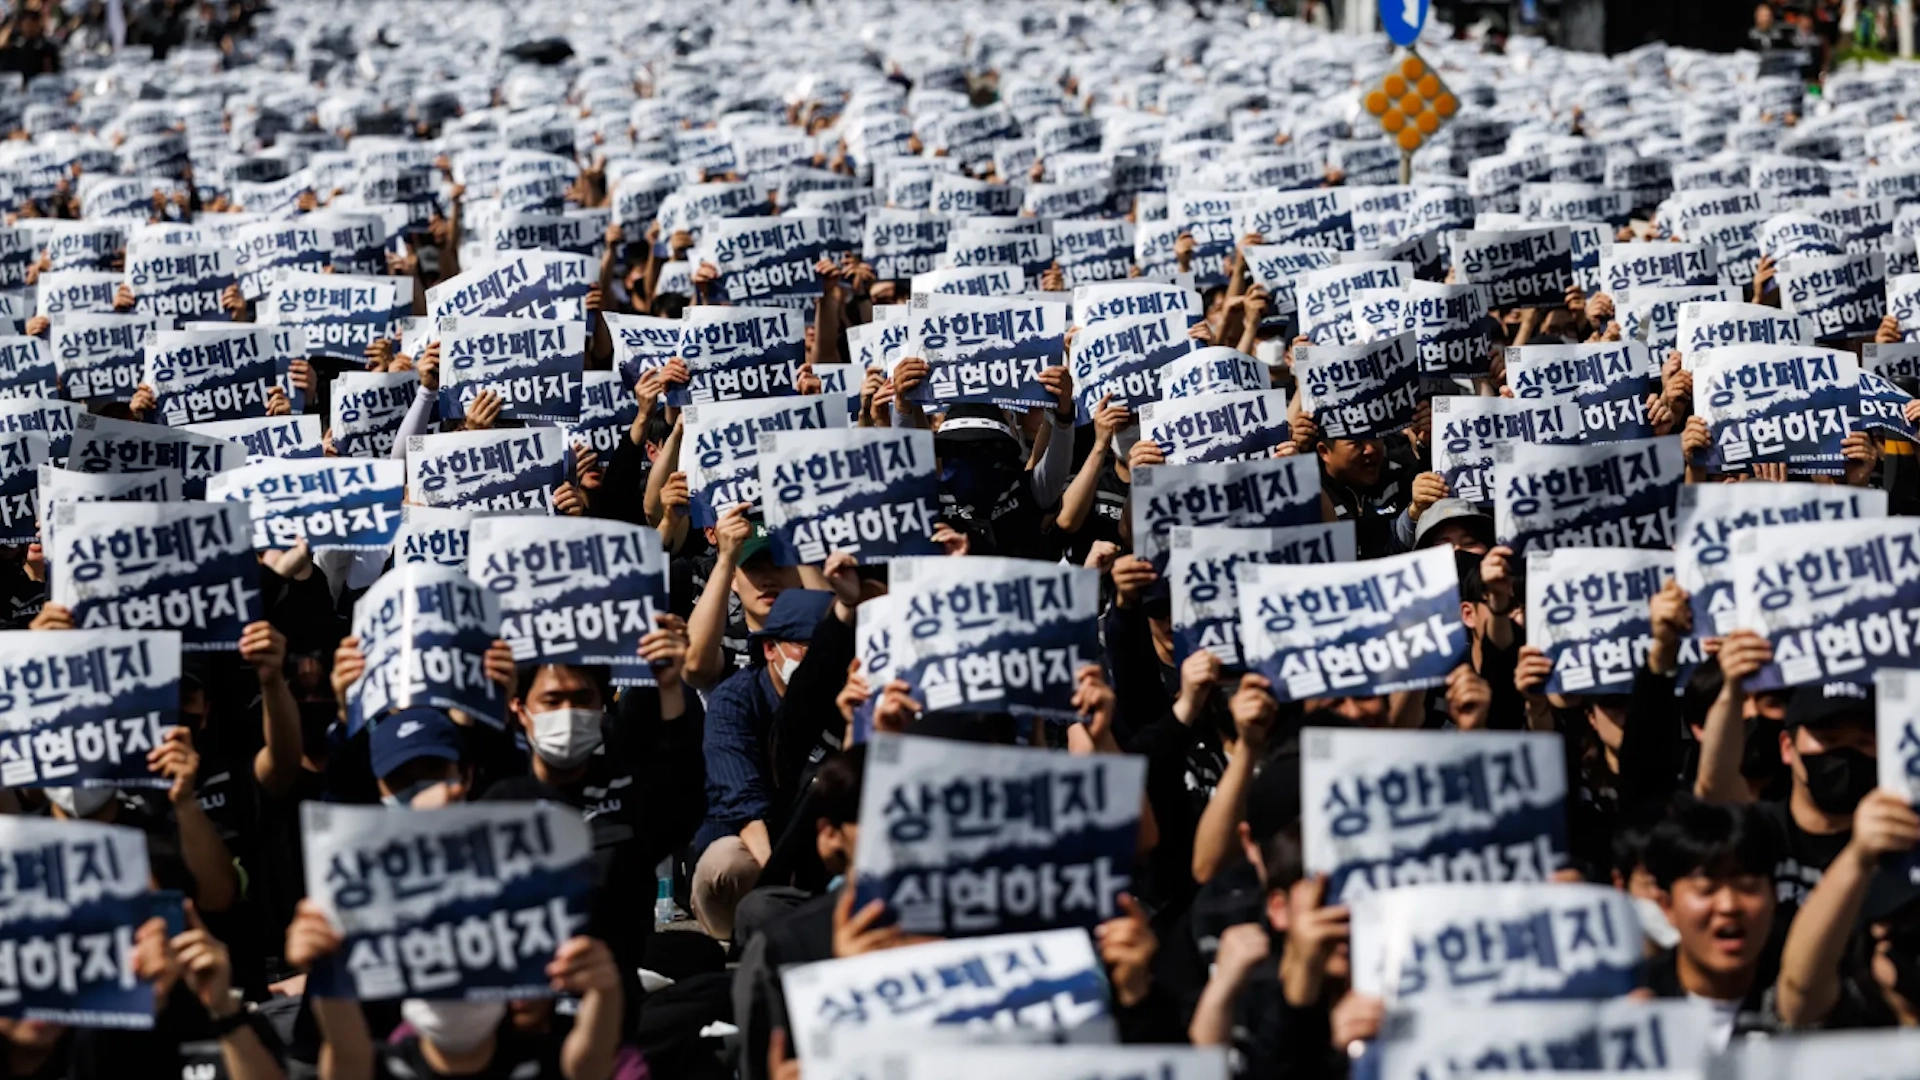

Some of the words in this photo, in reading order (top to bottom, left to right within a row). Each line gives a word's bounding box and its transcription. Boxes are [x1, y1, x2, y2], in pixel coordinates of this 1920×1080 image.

[685, 186, 755, 220] 상한폐지
[939, 187, 1011, 212] 상한폐지
[1182, 199, 1231, 217] 상한
[1252, 191, 1337, 235] 상한폐지
[1680, 192, 1761, 228] 상한폐지
[1819, 203, 1882, 230] 한폐지
[49, 227, 121, 258] 상한폐지
[236, 228, 318, 264] 상한폐지
[332, 226, 374, 248] 폐지
[496, 225, 580, 250] 상한폐지
[715, 227, 806, 262] 상한폐지
[953, 239, 1041, 267] 상한폐지
[1053, 226, 1124, 256] 상한폐지
[1462, 234, 1557, 275] 상한폐지
[1766, 222, 1837, 252] 상한폐지
[131, 252, 220, 286] 상한폐지
[547, 260, 586, 290] 폐지
[723, 259, 814, 301] 실현하자
[876, 253, 935, 282] 실현하
[934, 271, 1010, 295] 한폐지
[1257, 251, 1331, 281] 상한폐지
[1609, 249, 1708, 291] 상한폐지
[1788, 258, 1875, 303] 상한폐지
[48, 283, 118, 313] 상한폐
[278, 287, 376, 313] 상한폐지
[1086, 290, 1189, 320] 상한폐지
[1484, 270, 1570, 307] 현하자
[920, 307, 1045, 349] 상한폐지
[1402, 293, 1482, 330] 상한폐지
[1691, 317, 1799, 346] 상한폐지
[449, 326, 564, 370] 상한폐지
[682, 313, 789, 356] 상한폐지
[1074, 318, 1171, 379] 상한폐지
[1417, 334, 1491, 373] 현하자
[153, 332, 259, 384] 상한폐지
[930, 356, 1050, 397] 실현하자
[1306, 337, 1405, 398] 상한폐지
[1516, 346, 1634, 399] 상한폐지
[67, 364, 139, 400] 실현하
[580, 376, 630, 408] 폐지
[690, 361, 798, 402] 실현하자
[1705, 354, 1838, 408] 상한폐지
[162, 383, 270, 426] 실현하자
[340, 387, 416, 426] 상한폐
[1320, 383, 1419, 439] 실현하자
[1577, 395, 1648, 434] 하자
[1860, 398, 1912, 427] 하자
[242, 421, 301, 455] 폐지
[1150, 397, 1269, 456] 상한폐지
[1442, 405, 1565, 453] 상한폐지
[1718, 404, 1861, 461] 실현하자
[80, 440, 225, 476] 상한폐지
[418, 433, 544, 492] 상한폐지
[772, 435, 915, 502] 상한폐지
[1146, 462, 1299, 535] 상한폐지
[1508, 446, 1661, 516] 상한폐지
[67, 509, 237, 582] 상한폐지
[403, 528, 468, 567] 상한
[793, 496, 940, 565] 실현하자
[483, 531, 645, 593] 상한폐지
[82, 576, 261, 631] 실현하자
[905, 573, 1073, 638] 상한폐지
[1259, 562, 1427, 631] 상한폐지
[1542, 568, 1674, 624] 상한폐
[501, 595, 661, 660] 실현하자
[919, 645, 1080, 710] 실현하자
[1280, 613, 1463, 700] 실현하자
[0, 710, 178, 787] 실현하자
[883, 763, 1107, 843] 상한폐지
[1324, 742, 1538, 838] 상한폐지
[0, 836, 121, 903] 폐지
[326, 811, 553, 908] 상한폐지
[890, 857, 1131, 931] 실현하자
[0, 924, 138, 1000] 하자
[347, 896, 591, 1000] 실현하자
[819, 943, 1048, 1024] 상한폐지
